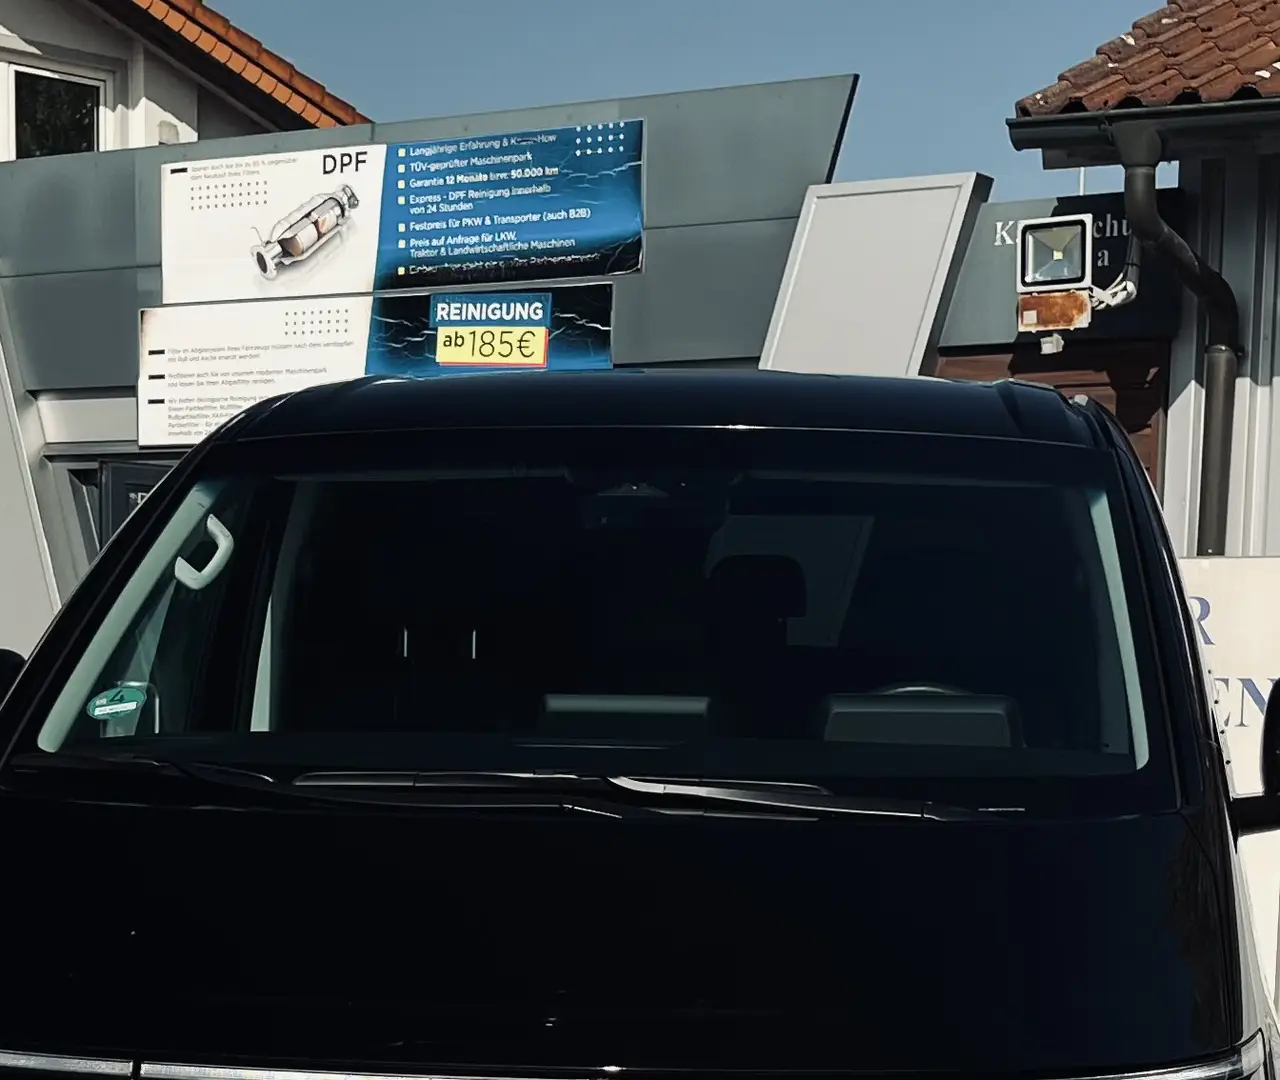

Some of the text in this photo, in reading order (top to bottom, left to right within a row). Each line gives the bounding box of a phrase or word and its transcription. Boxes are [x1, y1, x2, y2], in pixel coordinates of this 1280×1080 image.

[460, 140, 501, 151] Erfahrung
[502, 138, 509, 147] &
[323, 151, 368, 175] DPF
[410, 151, 533, 172] TÜV-geprüfter Maschinenpark
[410, 178, 444, 188] Garantie
[446, 175, 455, 185] 12
[457, 173, 488, 184] Monate
[511, 167, 543, 179] 50.000
[545, 166, 559, 176] km
[410, 194, 441, 205] Express
[448, 190, 466, 201] DPF
[468, 188, 510, 199] Reinigung
[410, 201, 474, 214] von 24 Stunden
[410, 207, 591, 231] Festpreis für PKW & Transporter (auch B2B)
[410, 238, 430, 248] Preis
[431, 235, 445, 245] auf
[447, 233, 480, 245] Anfrage
[481, 232, 493, 242] für
[410, 238, 575, 258] Traktor & Landwirtschaftliche Maschinen
[436, 302, 543, 321] REINIGUNG
[443, 330, 536, 358] ab 185€
